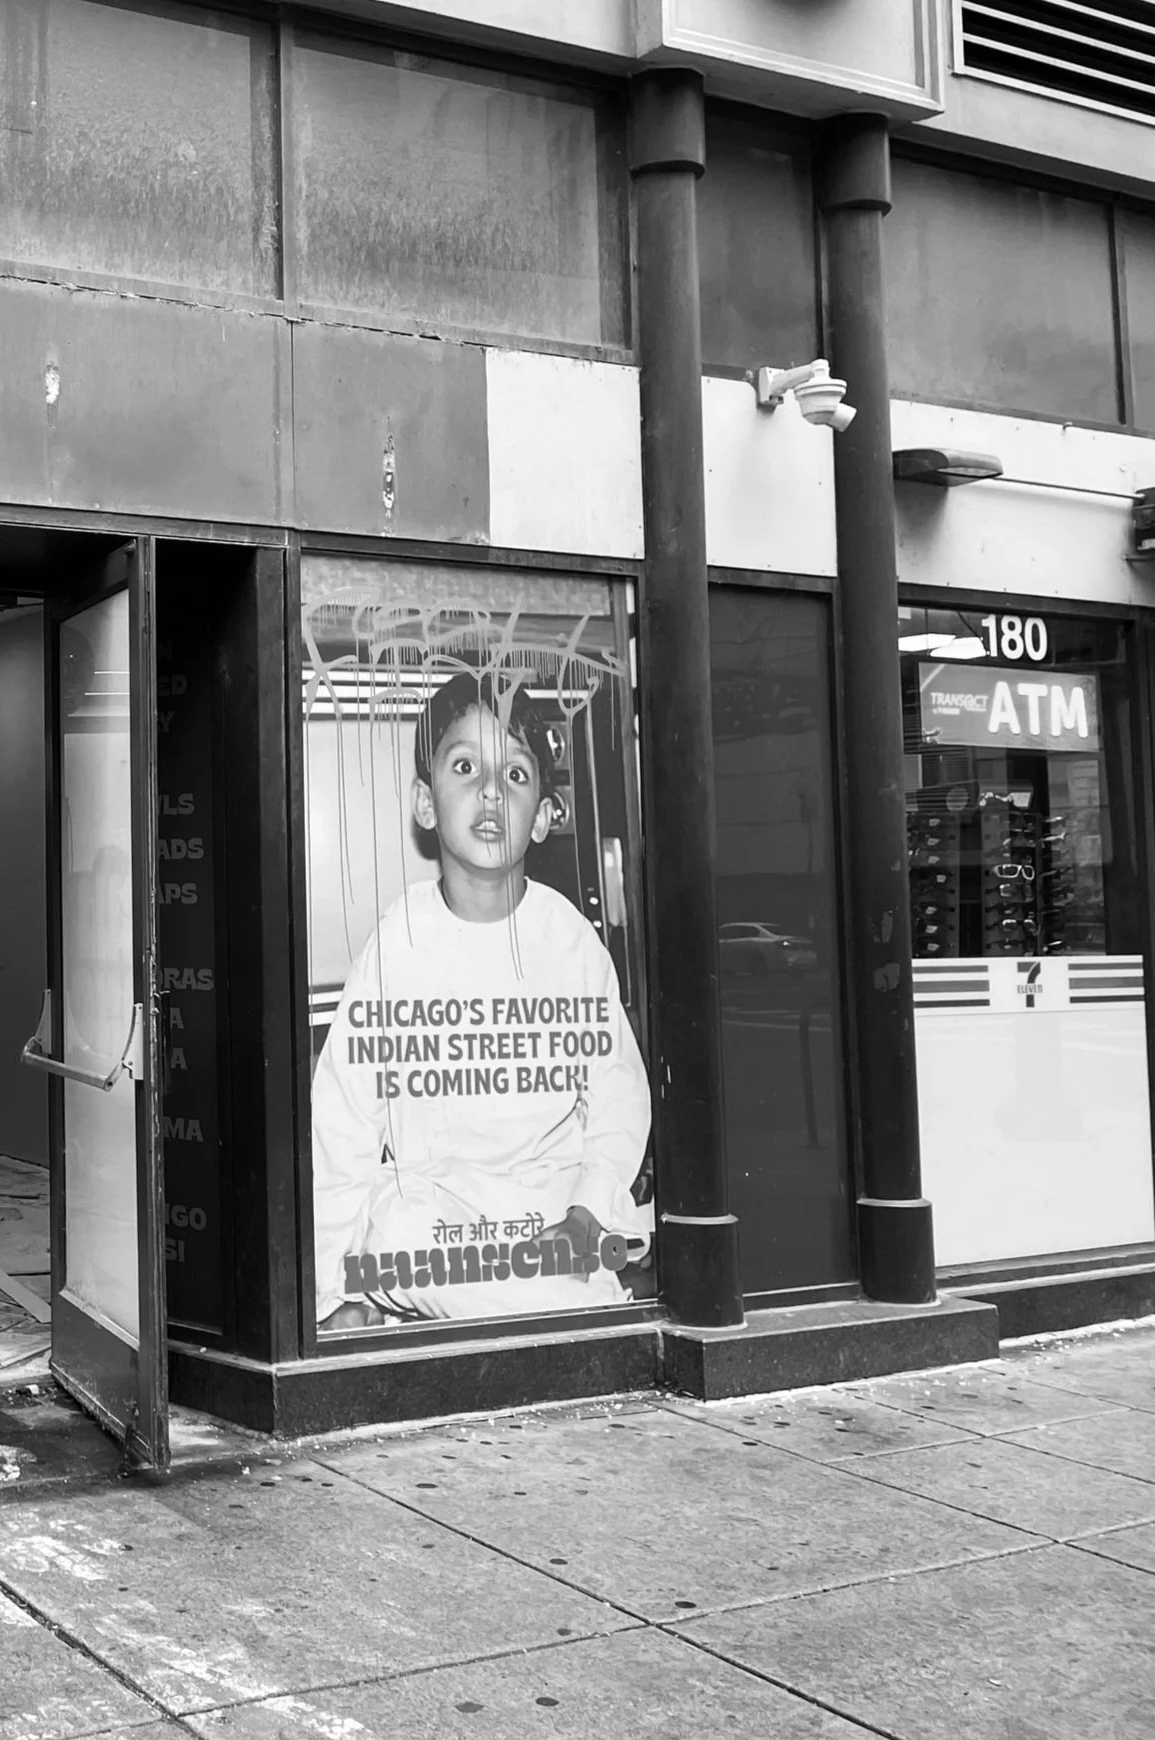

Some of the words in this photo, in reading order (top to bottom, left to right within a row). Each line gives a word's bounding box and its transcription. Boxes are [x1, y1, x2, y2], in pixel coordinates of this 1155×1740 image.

[981, 613, 1048, 661] 180
[988, 680, 1089, 738] ATM
[1017, 961, 1041, 1008] 7
[348, 998, 485, 1028] CHICAGO'S
[492, 997, 609, 1026] FAVORITE
[348, 1034, 440, 1064] INDIAN
[447, 1032, 541, 1061] STREET
[549, 1030, 613, 1058] FOOD
[376, 1071, 401, 1099] IS
[407, 1068, 509, 1097] COMING
[517, 1065, 589, 1093] BACK!
[432, 1219, 464, 1244] रोल
[469, 1214, 498, 1241] और
[503, 1212, 545, 1241] कटोरे
